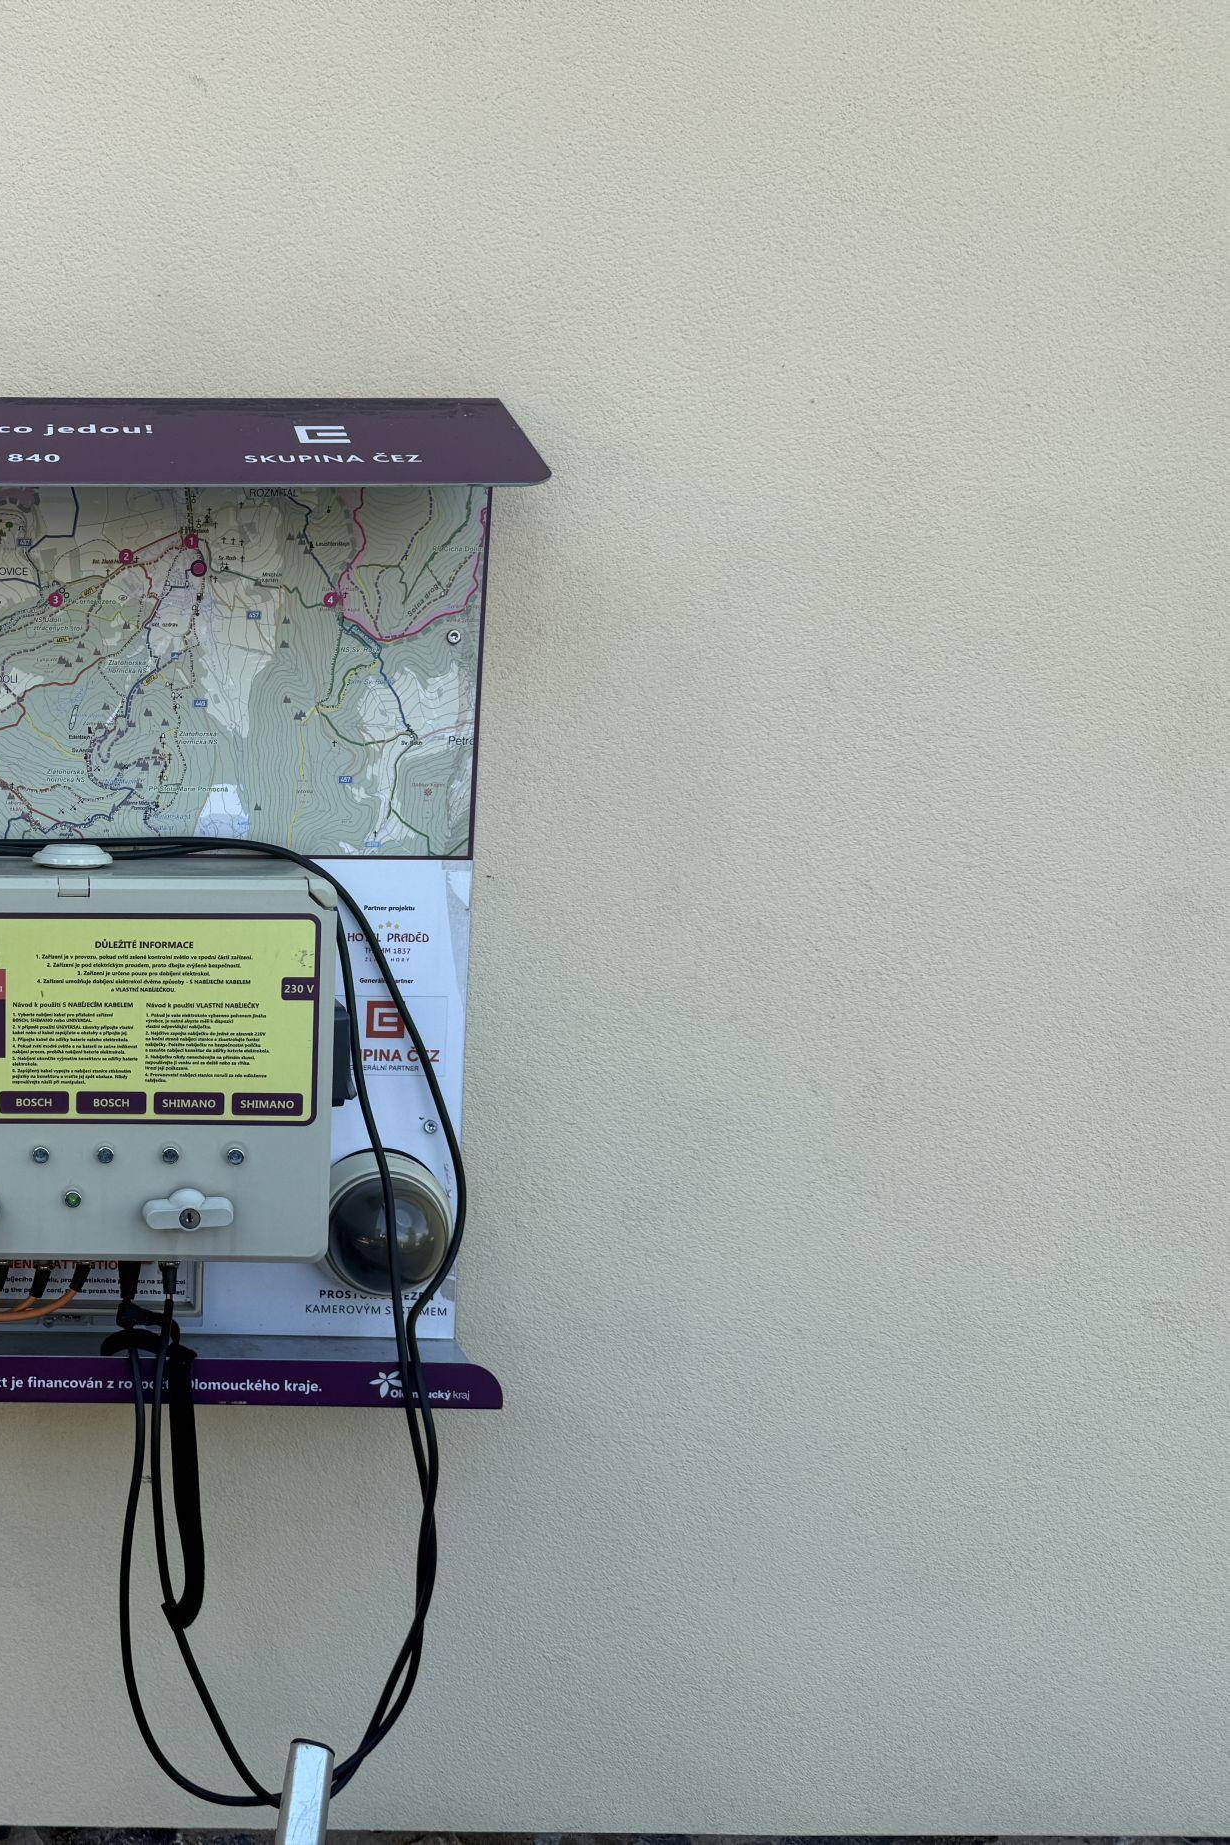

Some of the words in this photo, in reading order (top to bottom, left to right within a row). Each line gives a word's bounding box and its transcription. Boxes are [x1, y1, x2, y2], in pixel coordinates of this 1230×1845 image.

[43, 423, 154, 436] jedou!
[7, 452, 60, 463] 840
[244, 454, 365, 463] SKUPINA
[372, 452, 423, 463] ČEZ
[347, 932, 382, 943] HOL
[94, 938, 137, 949] DŮLEŽITÉ
[139, 941, 194, 949] INFORMACE
[284, 984, 304, 994] 230
[305, 984, 315, 994] V
[15, 1098, 53, 1107] BOSCH
[93, 1098, 130, 1108] BOSCH
[162, 1098, 216, 1108] SHIMANO
[240, 1099, 295, 1109] SHIMANO
[305, 1303, 381, 1315] KAMEROVÝM
[10, 1377, 24, 1390] je
[27, 1376, 103, 1389] financován
[107, 1380, 114, 1389] z
[191, 1378, 280, 1391] lomouckého
[285, 1379, 322, 1394] kraje.
[452, 1390, 470, 1401] kraj
